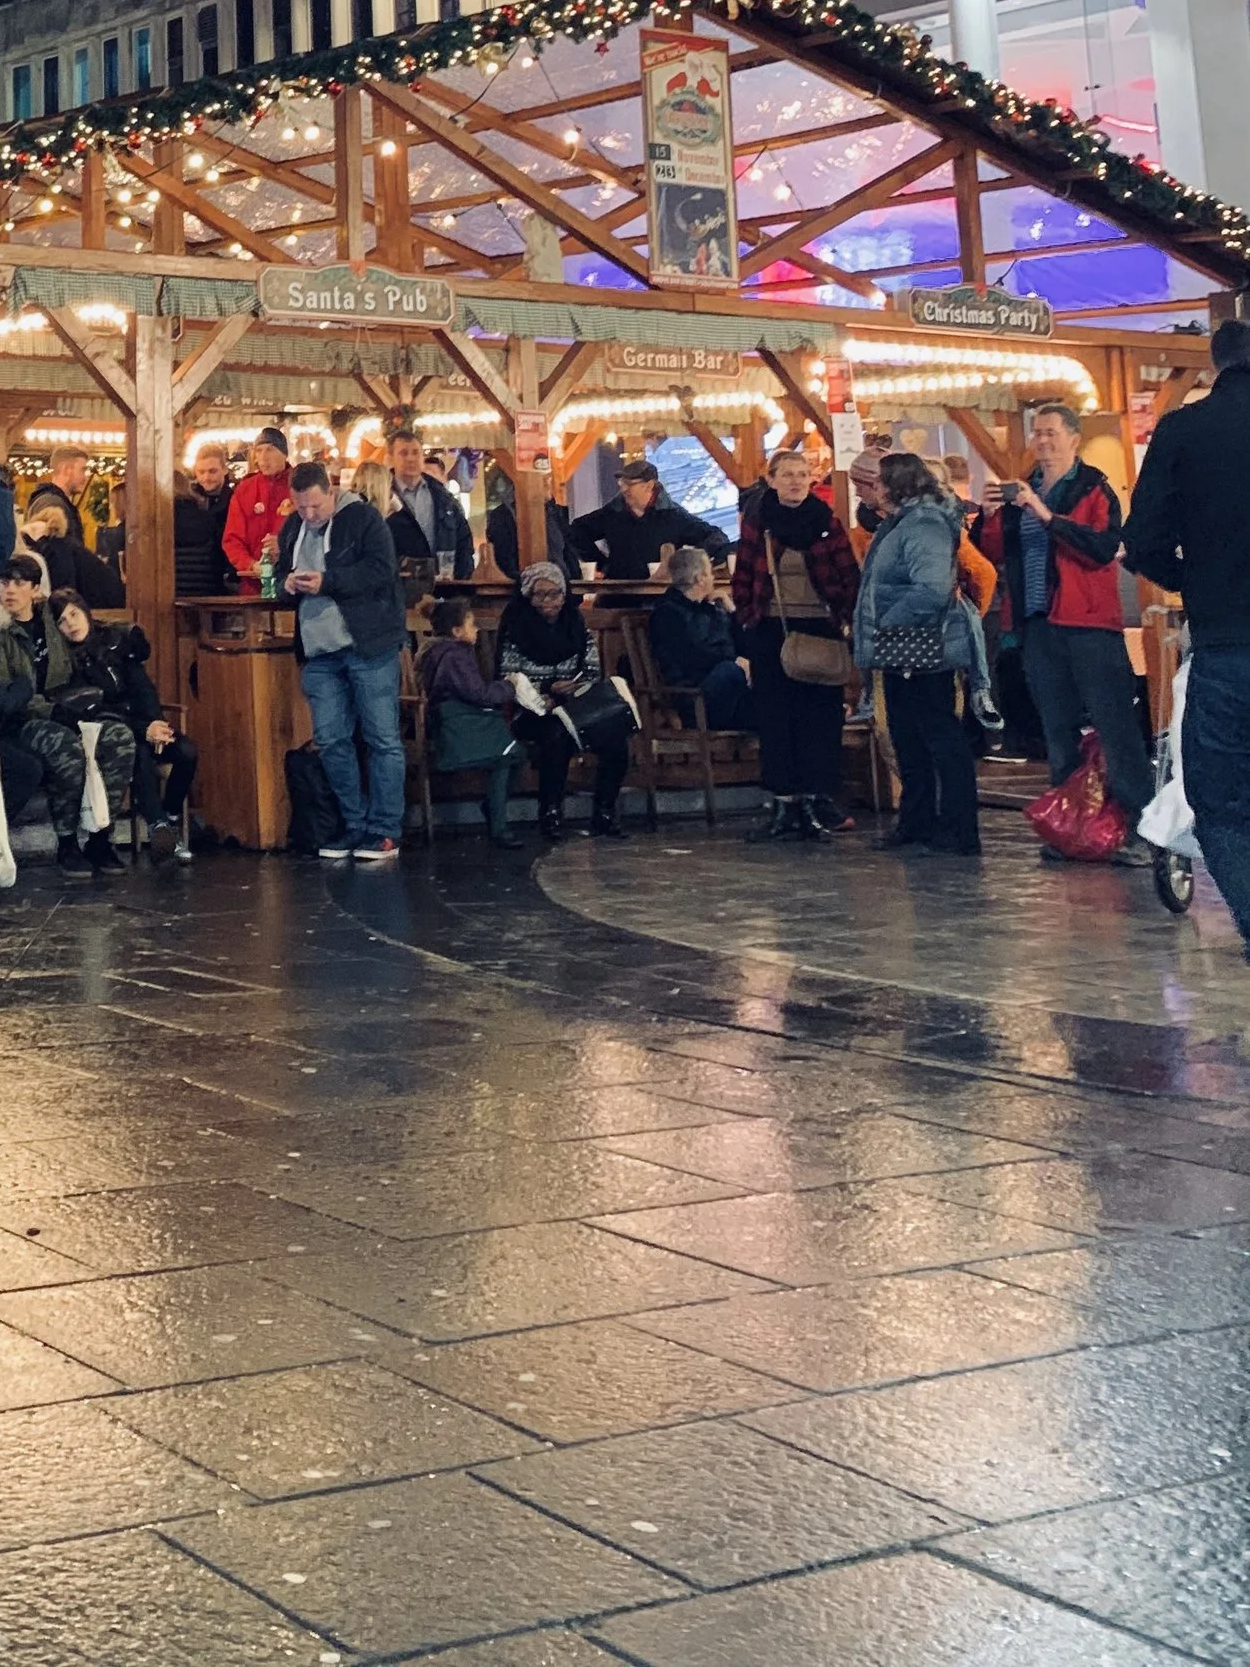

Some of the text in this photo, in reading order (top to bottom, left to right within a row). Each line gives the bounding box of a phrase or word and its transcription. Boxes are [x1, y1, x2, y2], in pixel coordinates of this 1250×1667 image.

[677, 149, 719, 166] November
[685, 167, 725, 184] December
[287, 282, 428, 313] Santa's Pub
[923, 300, 1039, 332] Christmas Party
[623, 346, 724, 370] German Bar
